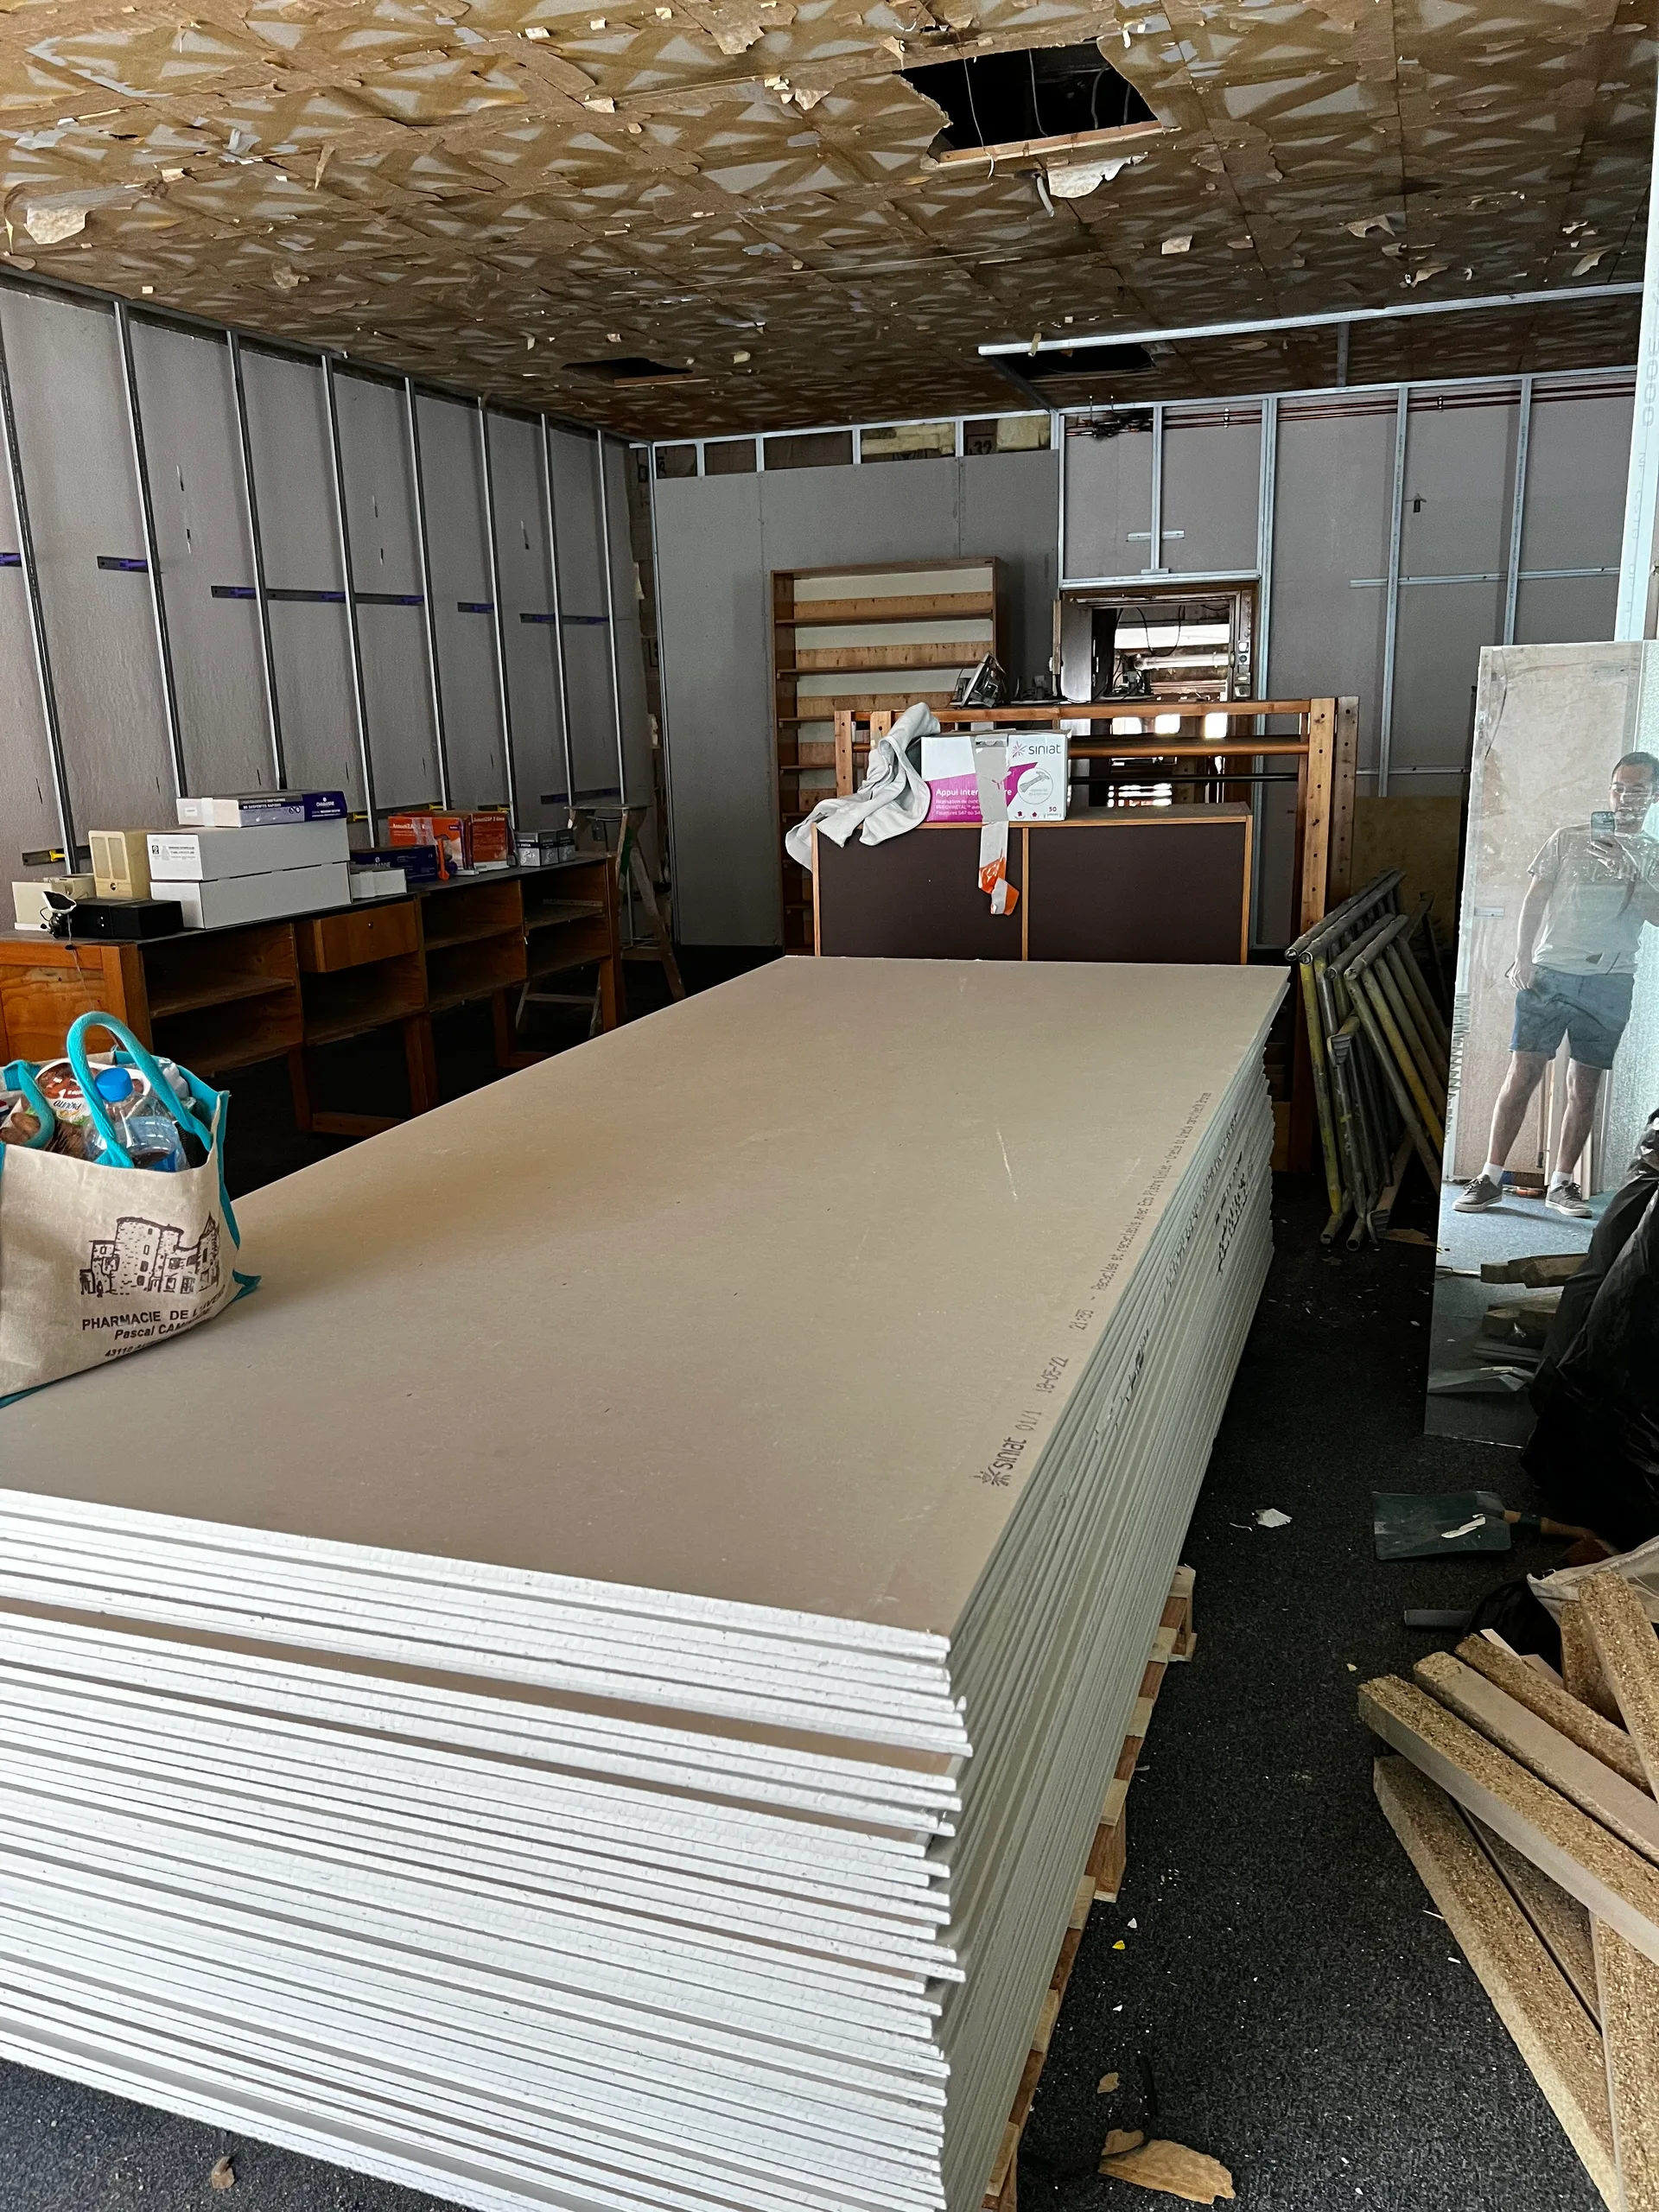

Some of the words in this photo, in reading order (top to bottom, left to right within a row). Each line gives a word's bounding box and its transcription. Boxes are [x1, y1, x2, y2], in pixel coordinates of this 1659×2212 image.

[1028, 744, 1062, 755] siniat
[936, 788, 959, 798] Appui
[81, 1311, 161, 1331] PHARMACIE
[169, 1310, 189, 1321] DE
[114, 1325, 155, 1340] Pascal
[993, 1436, 1027, 1470] siniat
